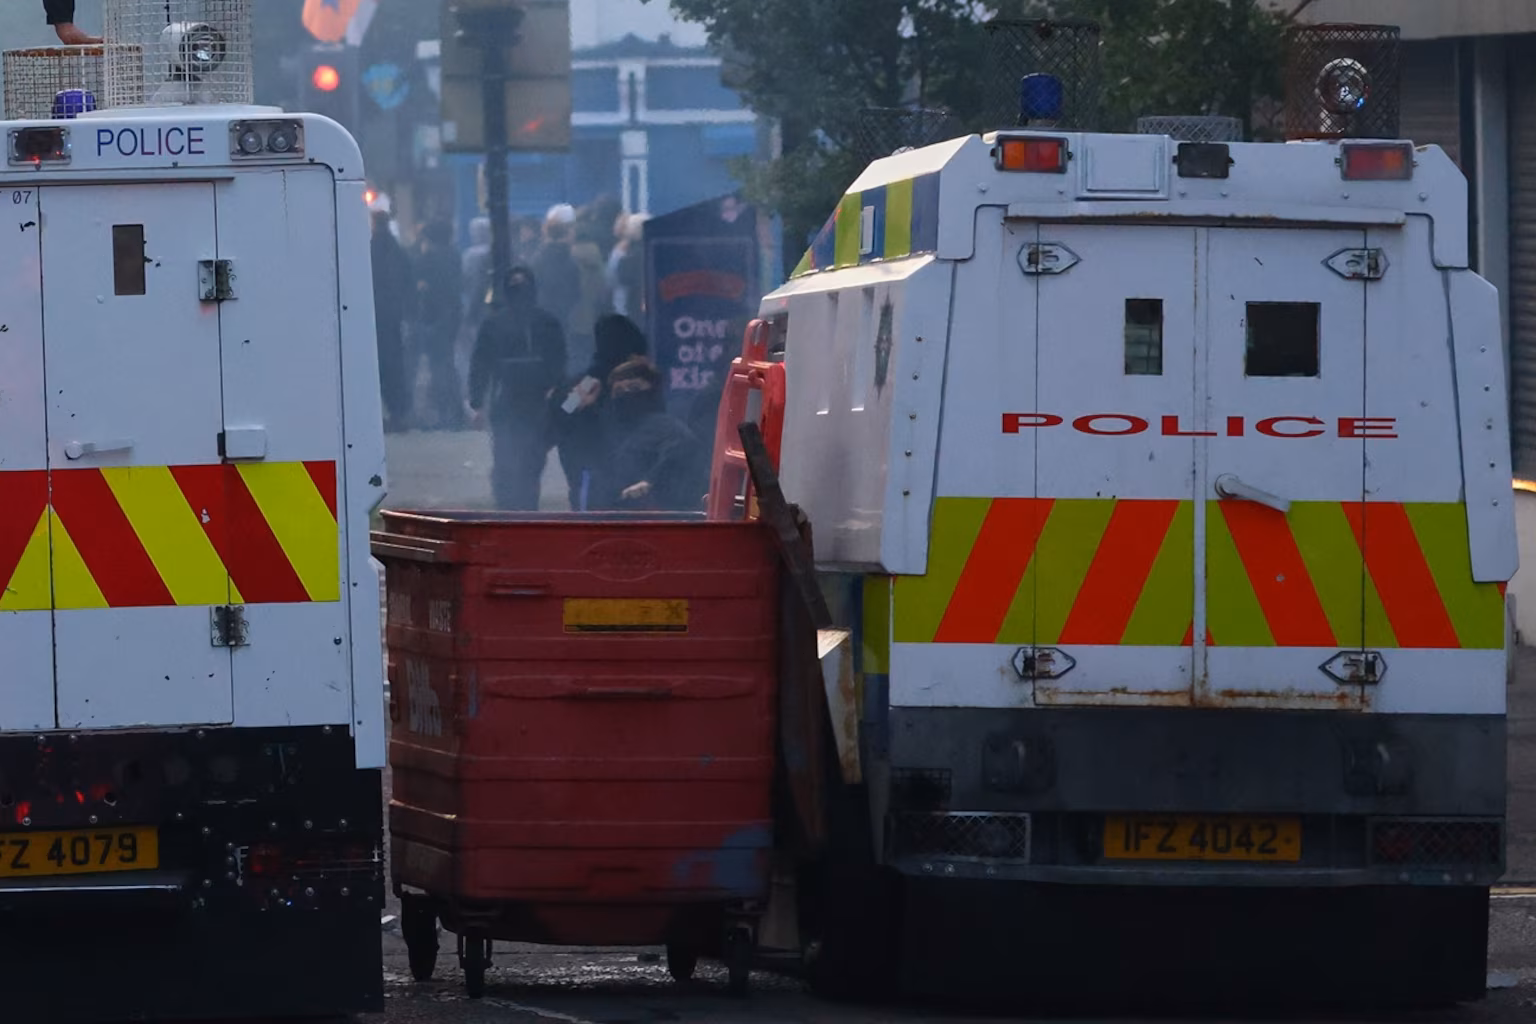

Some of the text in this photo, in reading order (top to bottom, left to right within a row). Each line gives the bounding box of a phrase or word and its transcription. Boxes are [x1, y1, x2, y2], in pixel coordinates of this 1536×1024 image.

[96, 127, 205, 157] POLICE
[12, 190, 32, 205] 07
[1001, 412, 1399, 439] POLICE
[47, 832, 138, 867] 4079
[1124, 821, 1279, 854] IFZ 4042
